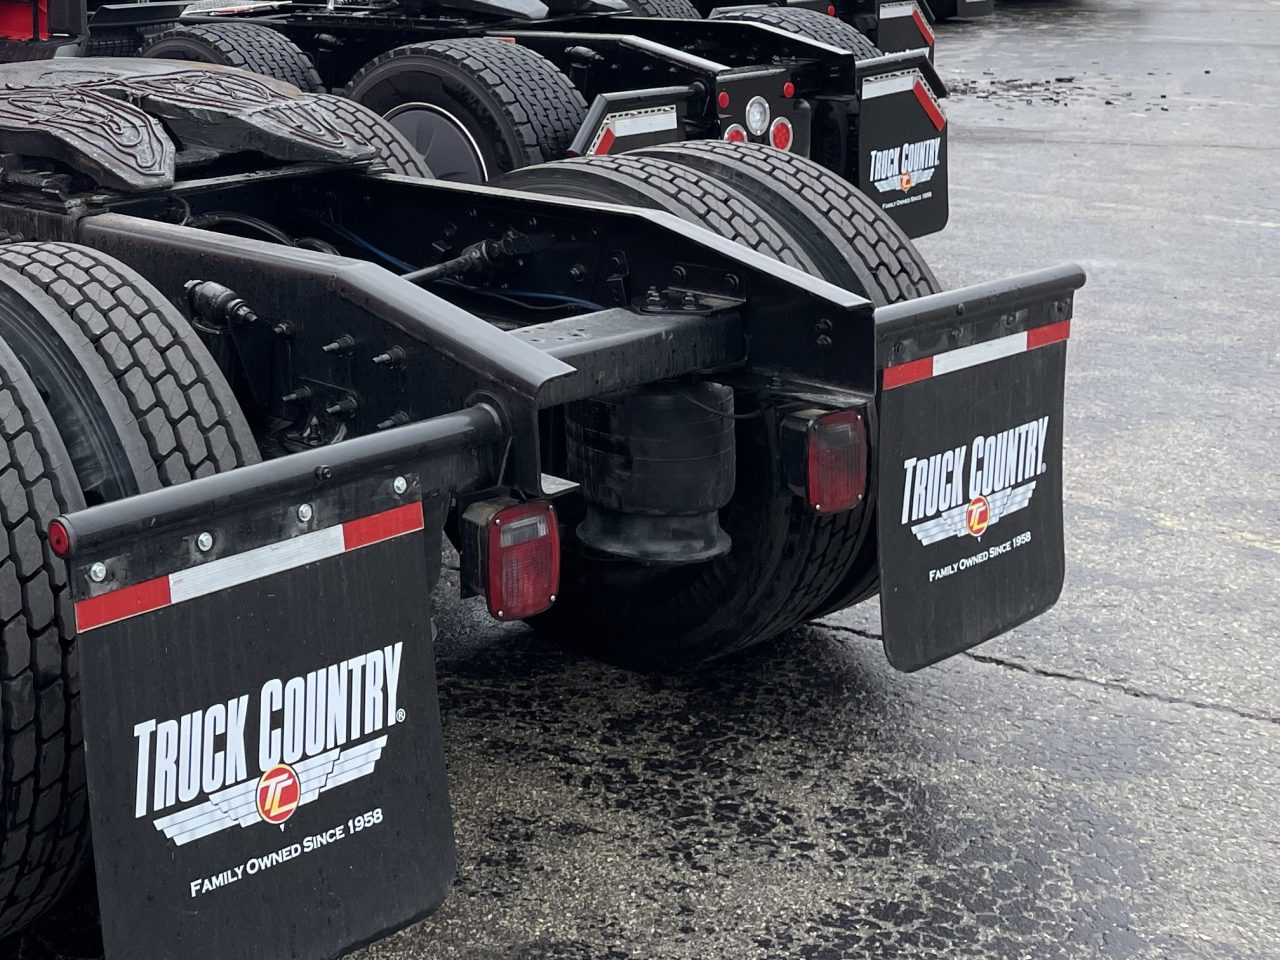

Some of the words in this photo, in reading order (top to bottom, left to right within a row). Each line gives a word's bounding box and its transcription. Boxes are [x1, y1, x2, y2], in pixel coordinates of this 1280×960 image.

[869, 146, 901, 182] TRUCK
[901, 445, 967, 525] TRUCK
[928, 562, 960, 582] FAMILY
[959, 550, 989, 570] OWNED
[989, 541, 1012, 559] SINCE
[1012, 531, 1032, 549] 1958
[132, 693, 250, 819] TRUCK
[259, 772, 296, 819] TC
[190, 865, 247, 898] FAMILY
[246, 841, 302, 876] OWNED
[302, 824, 346, 854] SINCE
[347, 808, 384, 835] 1958
